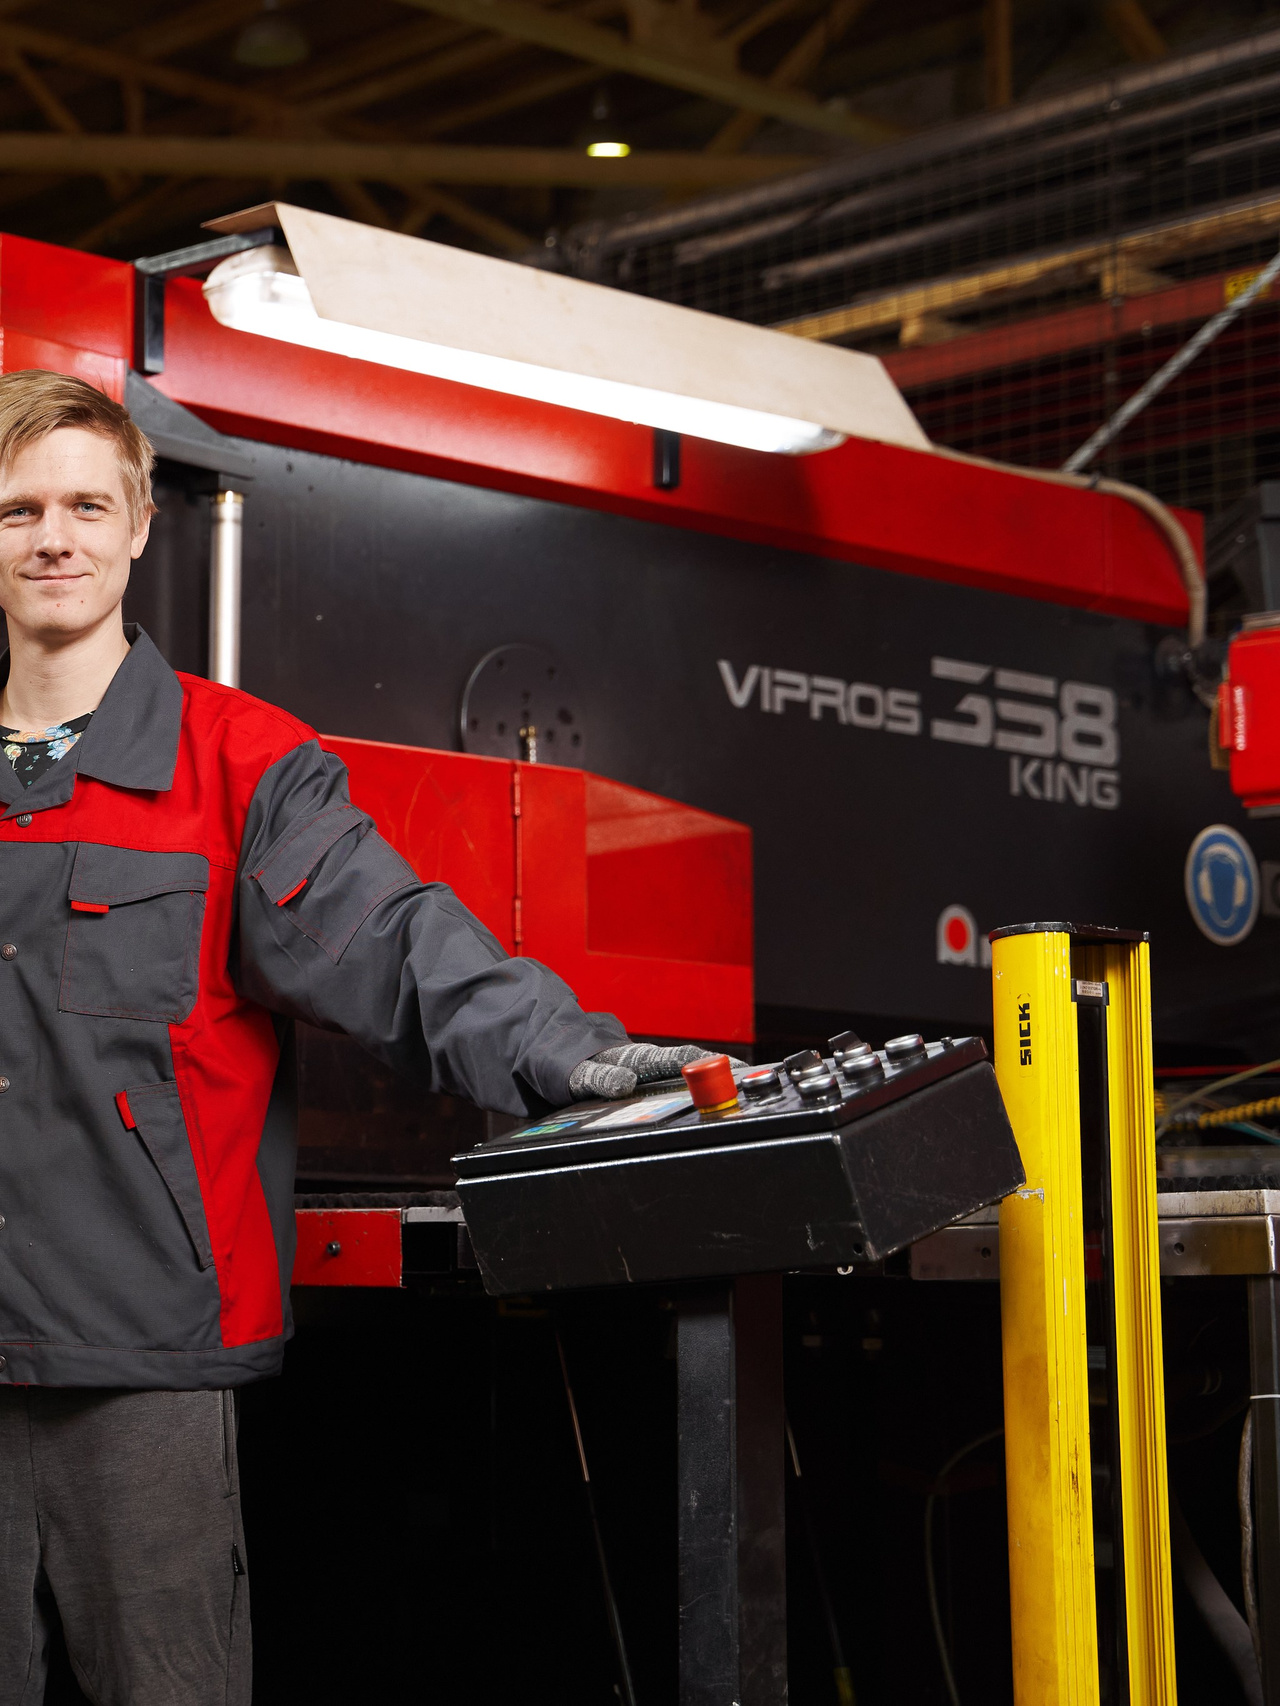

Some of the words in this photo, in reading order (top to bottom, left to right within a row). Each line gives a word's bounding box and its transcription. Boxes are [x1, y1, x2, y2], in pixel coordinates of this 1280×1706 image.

[716, 659, 923, 736] VIPROS
[930, 654, 1119, 767] 358
[1009, 755, 1121, 811] KING
[1017, 1002, 1032, 1066] SICK
